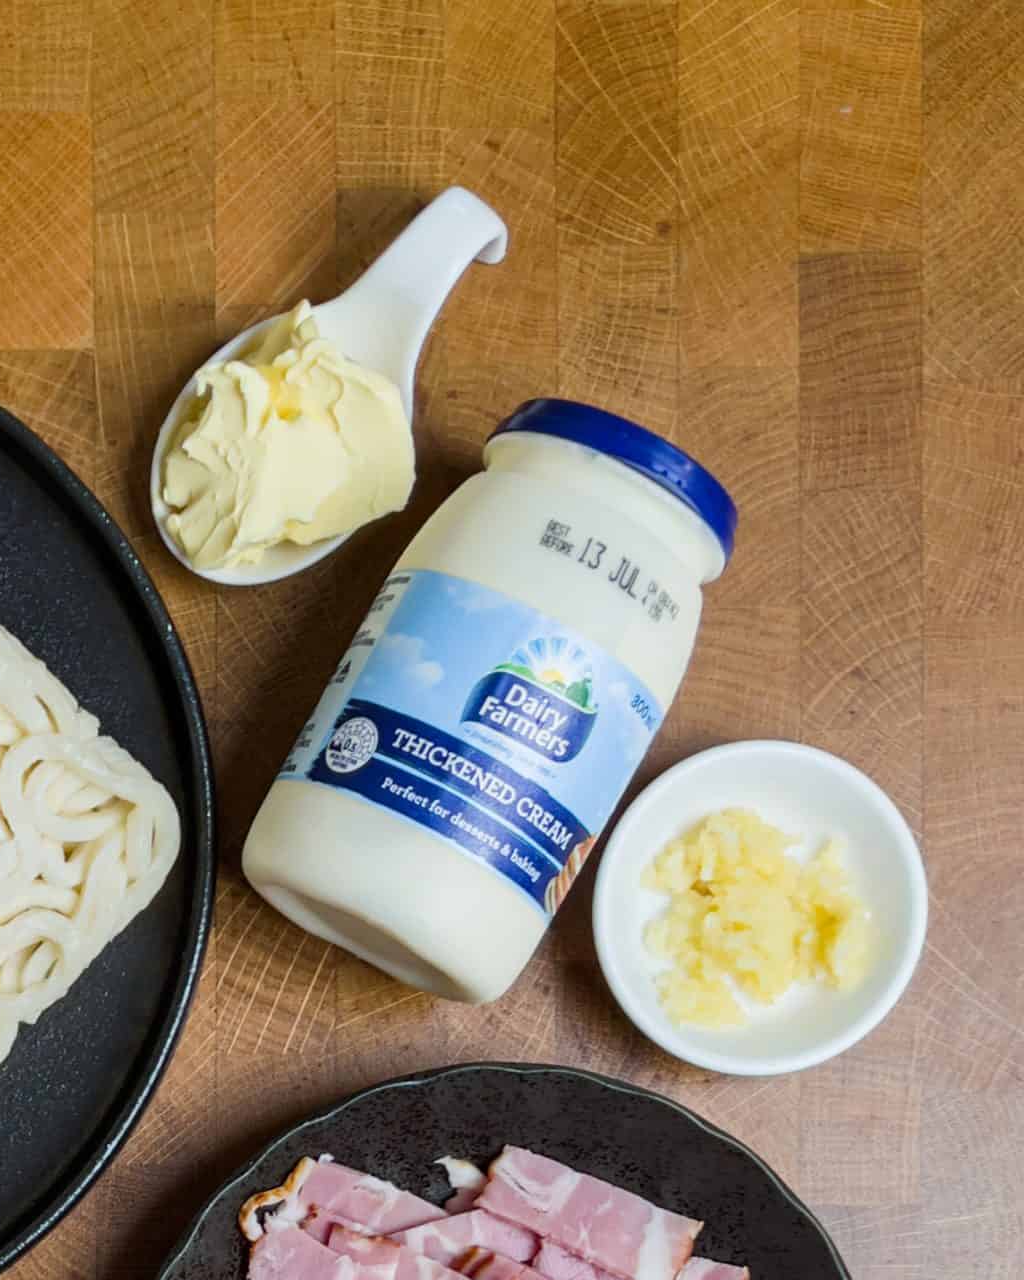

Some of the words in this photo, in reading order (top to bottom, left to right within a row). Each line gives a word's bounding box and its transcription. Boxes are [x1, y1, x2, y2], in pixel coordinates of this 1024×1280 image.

[577, 537, 607, 570] 13
[608, 556, 640, 599] JUL
[479, 696, 569, 756] Farmers
[504, 683, 566, 731] Dairy
[393, 728, 516, 805] THICKENED
[516, 797, 573, 850] CREAM
[381, 777, 427, 808] Perfect
[429, 798, 450, 819] for
[450, 810, 500, 850] desserts
[501, 844, 510, 855] &
[510, 848, 541, 882] baking
